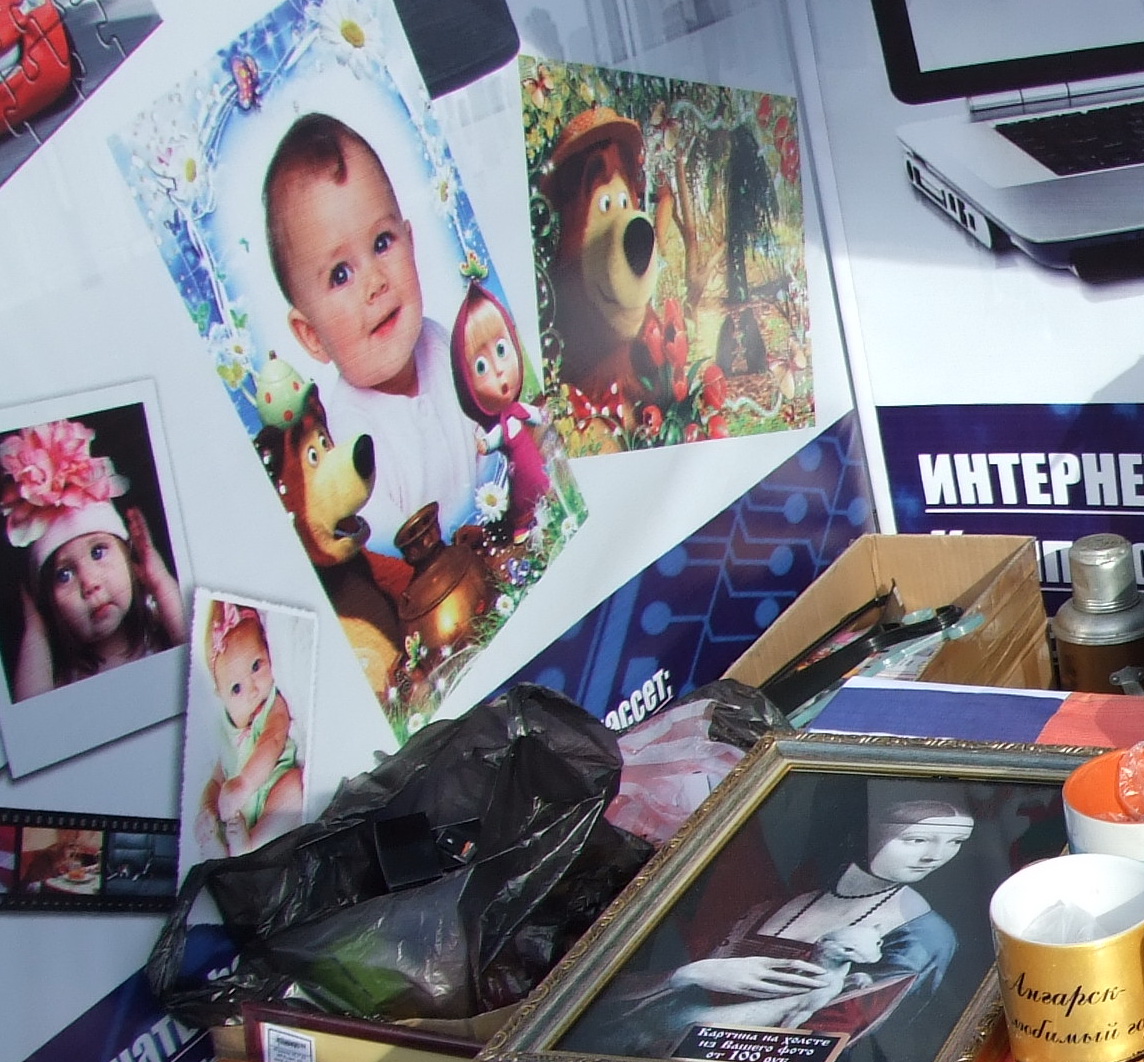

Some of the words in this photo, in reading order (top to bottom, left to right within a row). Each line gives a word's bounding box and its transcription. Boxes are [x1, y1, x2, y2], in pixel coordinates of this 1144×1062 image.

[697, 1027, 757, 1041] Картина
[762, 1035, 778, 1043] на
[728, 1051, 760, 1062] 100
